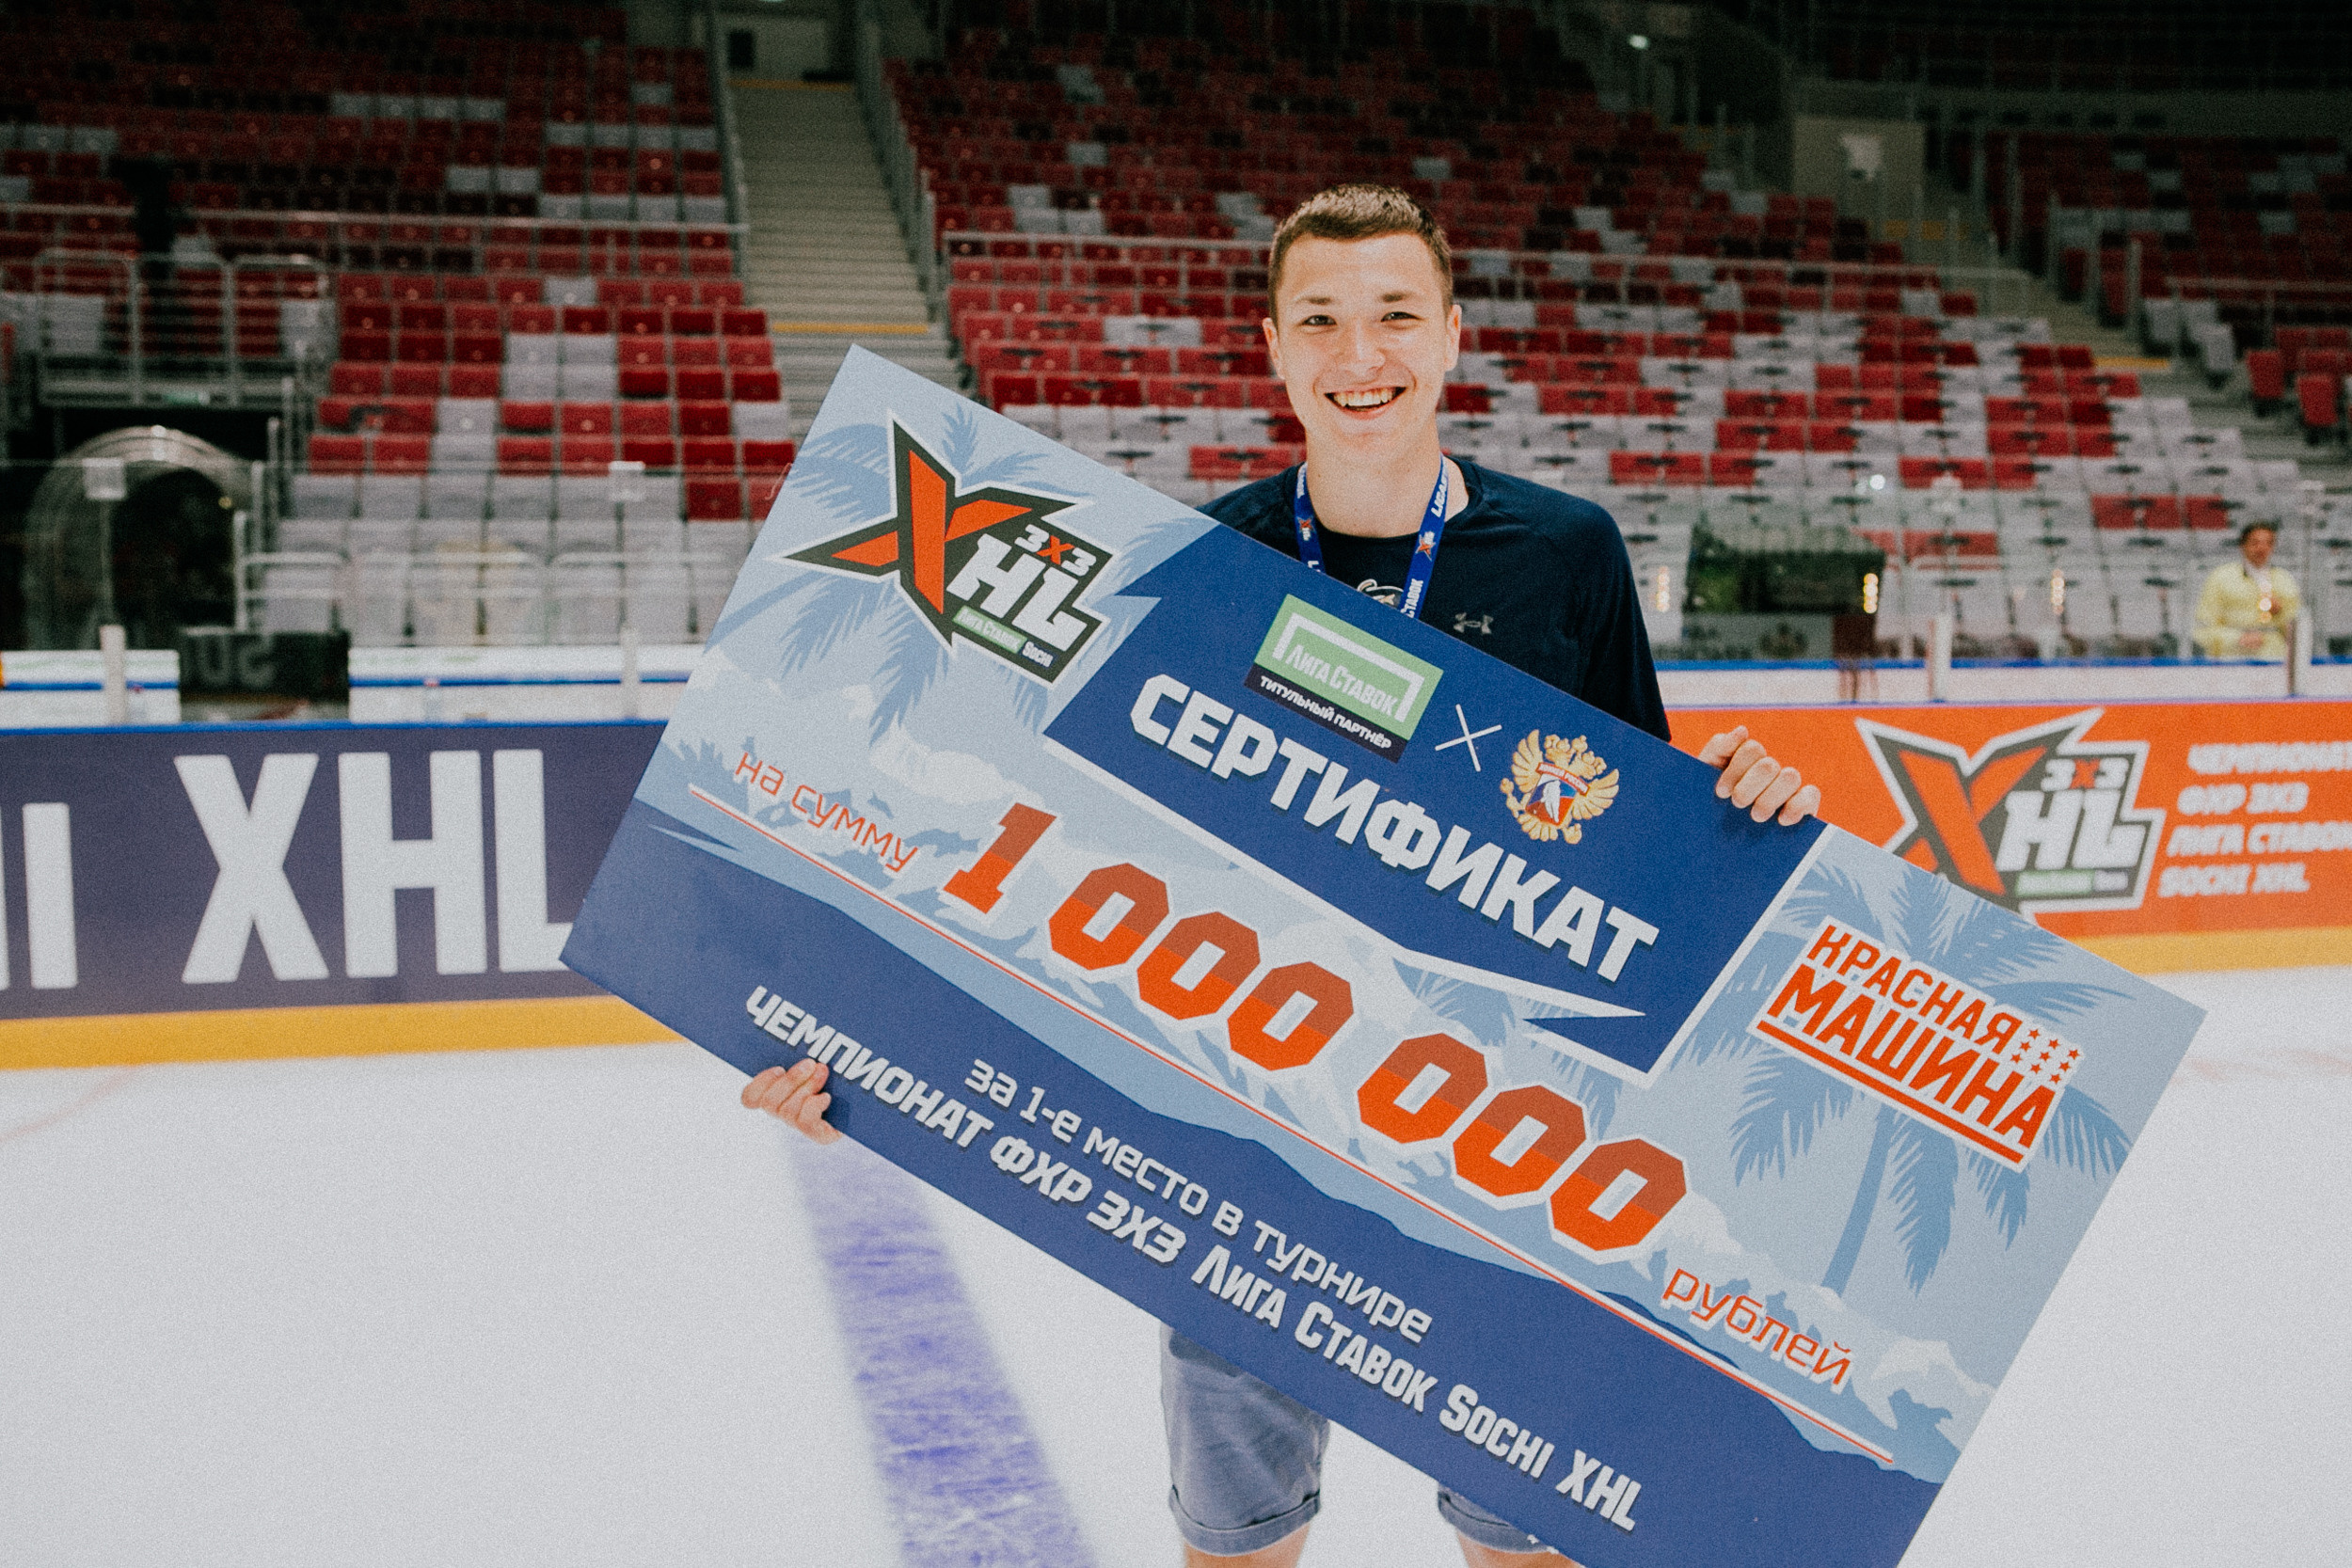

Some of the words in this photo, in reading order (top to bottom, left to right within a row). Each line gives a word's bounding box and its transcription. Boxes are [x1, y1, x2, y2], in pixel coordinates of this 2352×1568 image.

[1130, 673, 1660, 984] СЕРТИФИКАТ
[1260, 674, 1335, 721] ТИТУЛЬНЫЙ
[1333, 712, 1392, 750] ПАРТНЁР
[173, 749, 575, 984] XHL
[1806, 924, 2024, 1055] КРАСНАЯ
[735, 751, 784, 798] на
[790, 784, 918, 874] сумму
[943, 802, 1057, 915] 1
[1048, 862, 1355, 1071] 000
[1356, 1032, 1688, 1252] 000
[1661, 1267, 1851, 1386] рублей
[1766, 963, 2057, 1149] МАШИНА
[745, 984, 995, 1148] ЧЕМПИОНАТ
[990, 1134, 1094, 1207] ФХР
[1554, 1449, 1644, 1532] XHL
[963, 1057, 1020, 1110] за
[1019, 1086, 1083, 1145] 1-е
[1083, 1126, 1210, 1216] место
[1211, 1200, 1245, 1238] в
[1252, 1219, 1434, 1344] турнире
